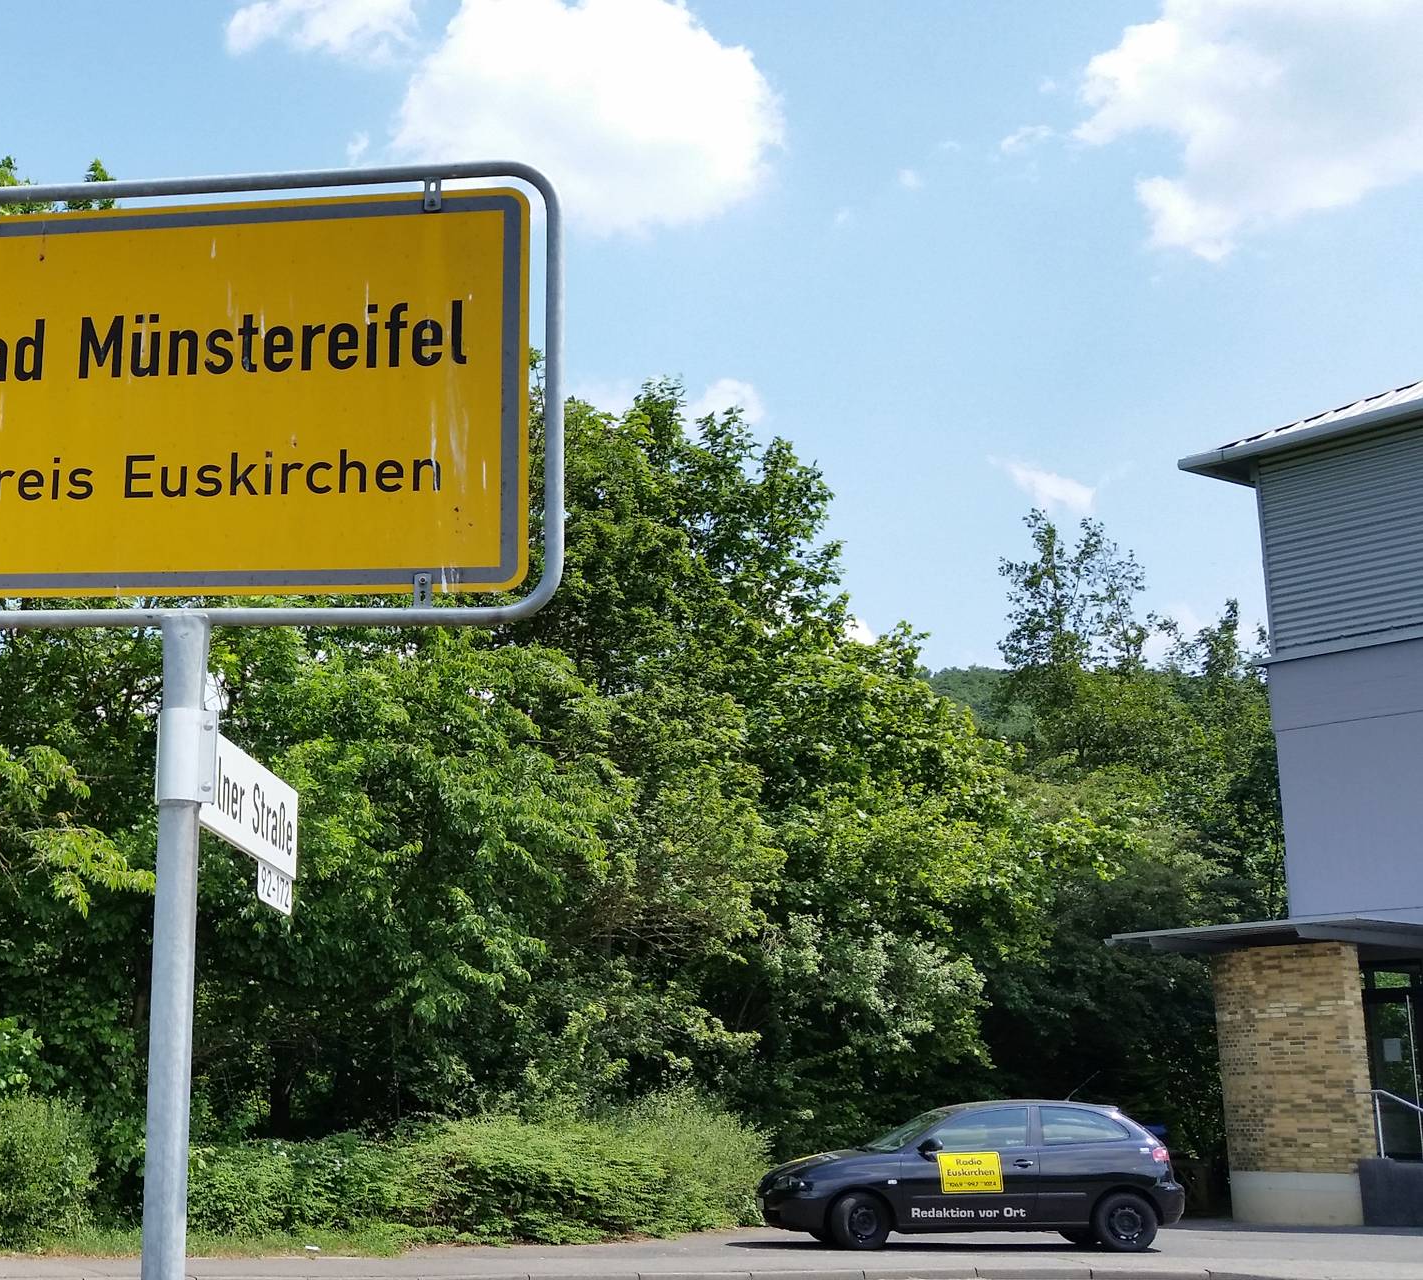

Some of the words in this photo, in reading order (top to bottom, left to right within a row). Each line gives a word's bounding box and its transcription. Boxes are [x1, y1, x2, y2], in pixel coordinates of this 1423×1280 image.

[78, 299, 468, 380] Münstereifel
[124, 448, 442, 499] Euskirchen
[212, 756, 245, 824] lner
[252, 783, 292, 856] Straße
[261, 866, 290, 908] 92-172
[947, 1168, 995, 1177] Euskirchen
[956, 1157, 982, 1166] Radio
[911, 1207, 975, 1218] Redaktion
[978, 1209, 1000, 1218] vor
[1003, 1207, 1027, 1218] Ort
